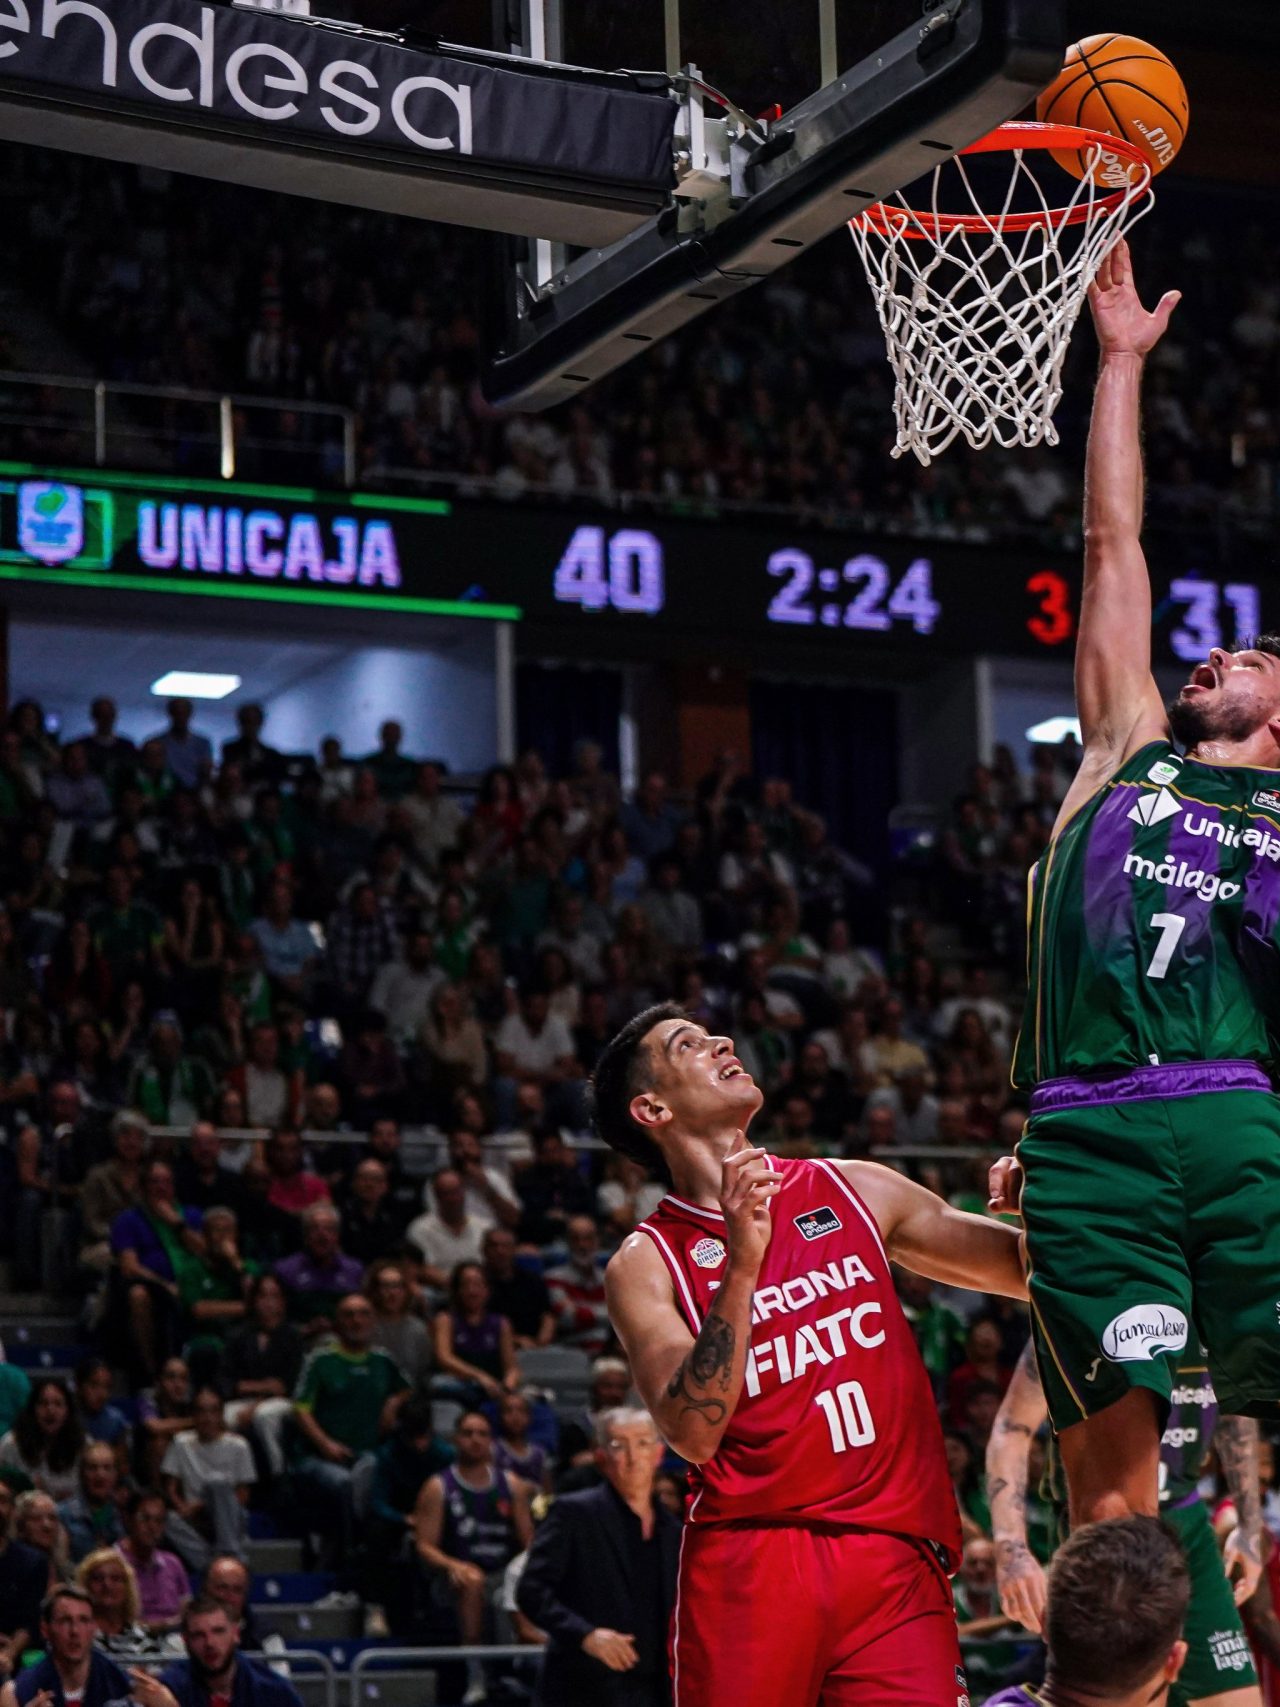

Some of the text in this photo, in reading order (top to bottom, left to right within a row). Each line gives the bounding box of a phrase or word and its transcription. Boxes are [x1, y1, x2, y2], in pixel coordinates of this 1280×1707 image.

[138, 500, 402, 588] UNICAJA
[554, 525, 664, 616] 40
[767, 547, 940, 634] 2:24
[1026, 570, 1073, 645] 3
[1169, 579, 1262, 662] 31
[1122, 854, 1241, 903] málaga
[1146, 912, 1186, 979] 7
[697, 1249, 725, 1266] GIRONA
[801, 1220, 818, 1231] liga
[806, 1220, 839, 1237] endesa
[745, 1301, 886, 1398] FIATC
[1111, 1309, 1185, 1356] famadesa
[814, 1380, 876, 1453] 10
